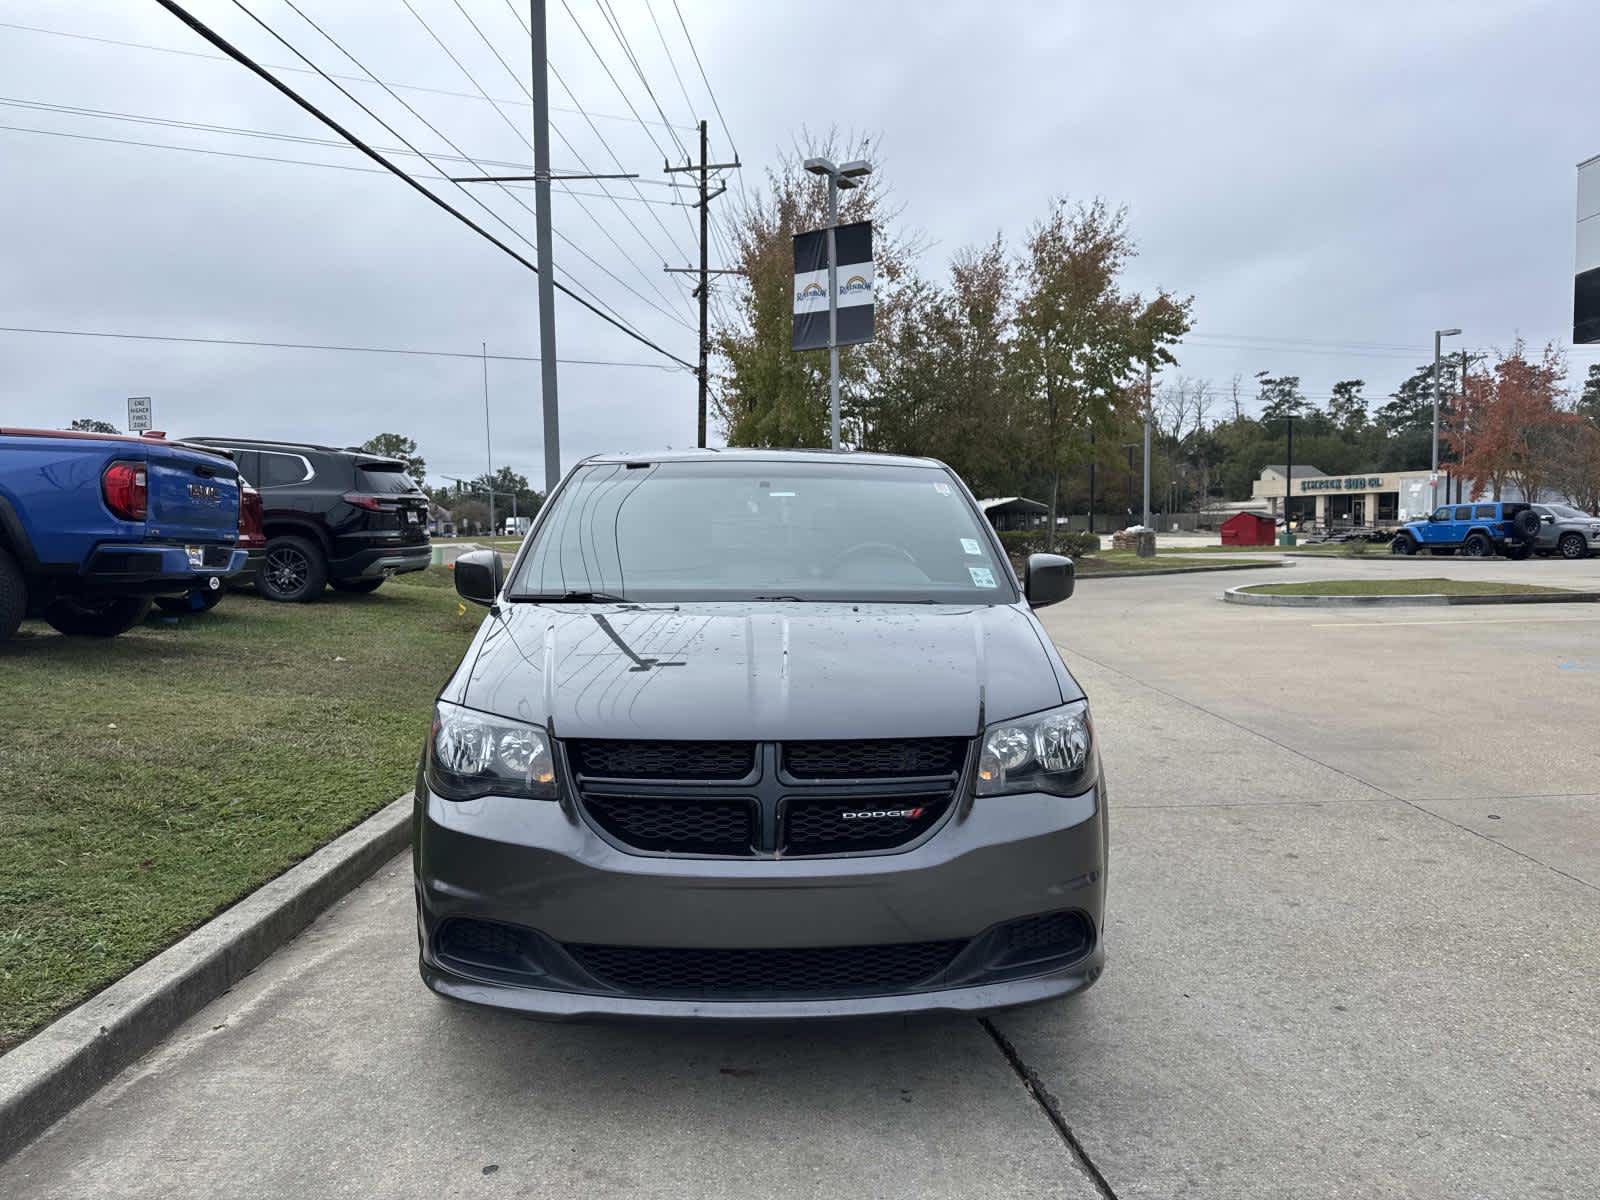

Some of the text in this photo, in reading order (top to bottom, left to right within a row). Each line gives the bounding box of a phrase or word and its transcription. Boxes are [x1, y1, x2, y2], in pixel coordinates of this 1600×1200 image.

[796, 288, 827, 301] RAINBOW
[839, 281, 873, 296] RAINBOW
[842, 809, 913, 819] DODGE
